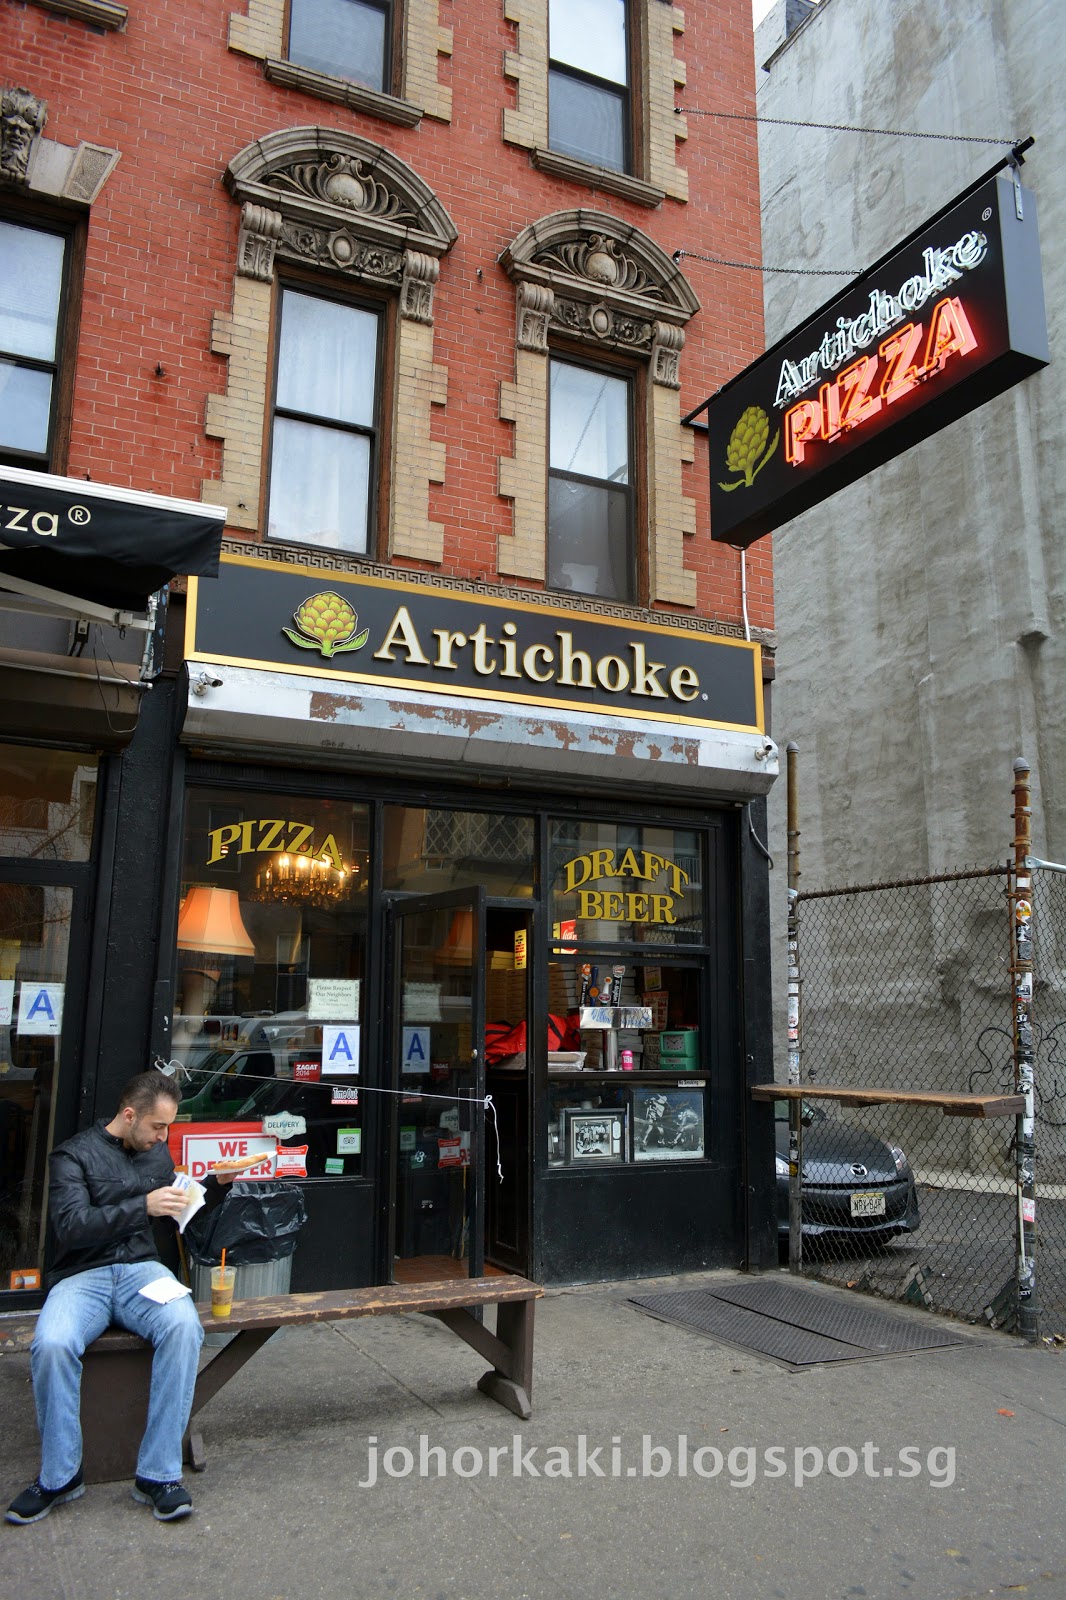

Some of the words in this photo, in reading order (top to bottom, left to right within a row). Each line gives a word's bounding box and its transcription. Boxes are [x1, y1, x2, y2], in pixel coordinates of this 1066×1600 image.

[773, 230, 988, 407] Artichoke
[784, 296, 978, 467] PIZZA
[373, 605, 700, 702] Artichoke
[206, 819, 347, 875] PIZZA
[563, 847, 689, 898] DRAFT
[577, 889, 677, 925] BEER
[26, 989, 55, 1020] A
[328, 1032, 353, 1060] A
[267, 1121, 299, 1129] DELIVERY
[218, 1141, 248, 1157] WE
